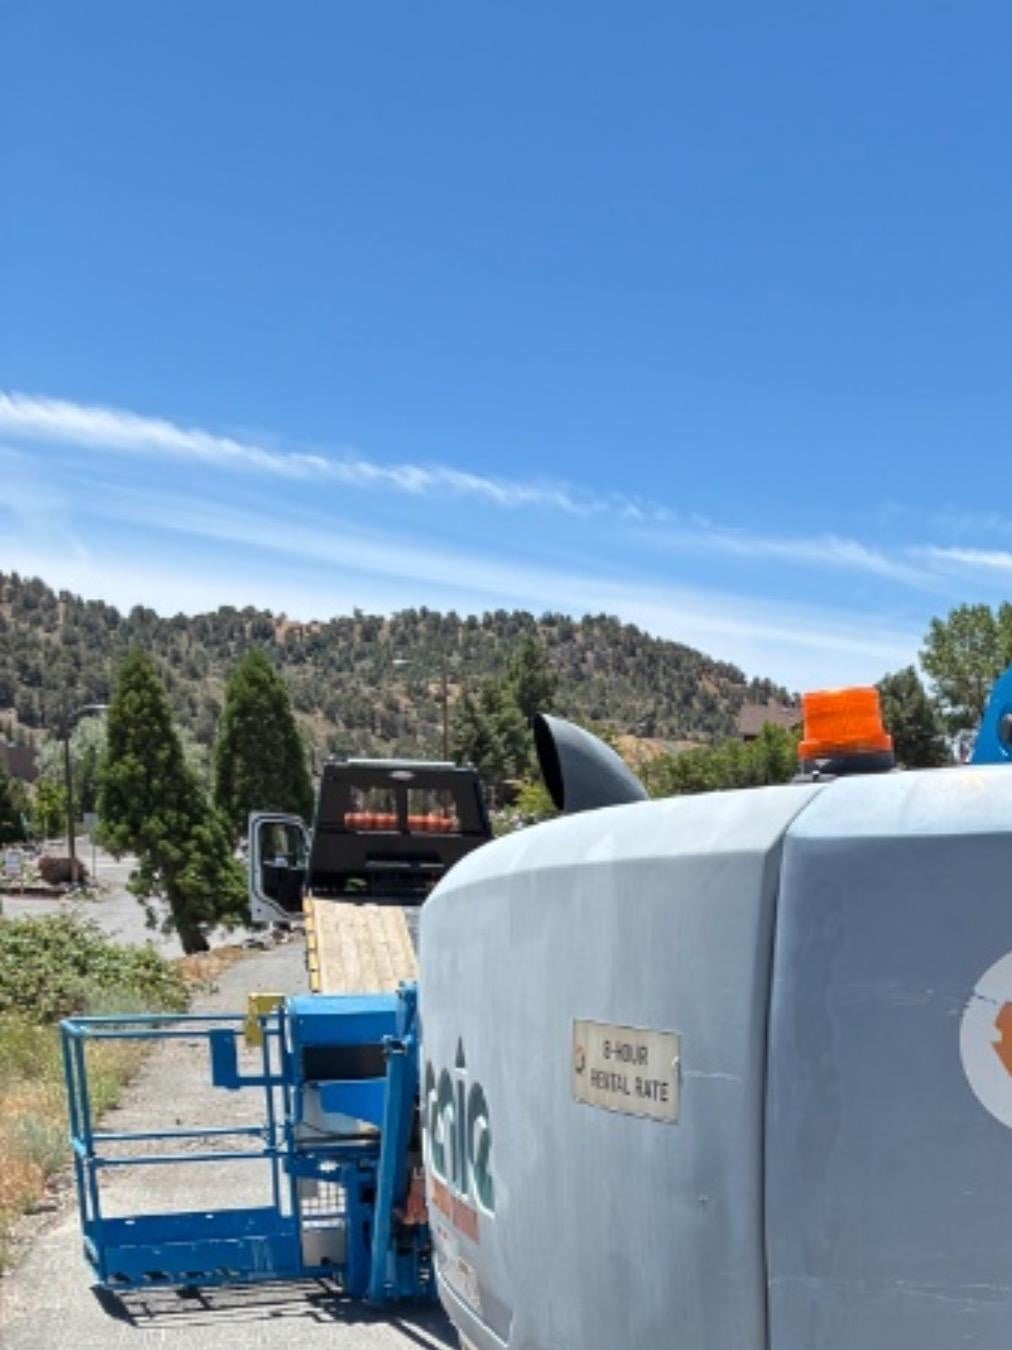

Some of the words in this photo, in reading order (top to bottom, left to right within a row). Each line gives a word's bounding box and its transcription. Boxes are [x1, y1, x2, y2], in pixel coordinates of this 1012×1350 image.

[603, 1039, 649, 1067] 8-HOUR
[590, 1067, 631, 1097] RENTAL
[635, 1076, 670, 1104] RATE
